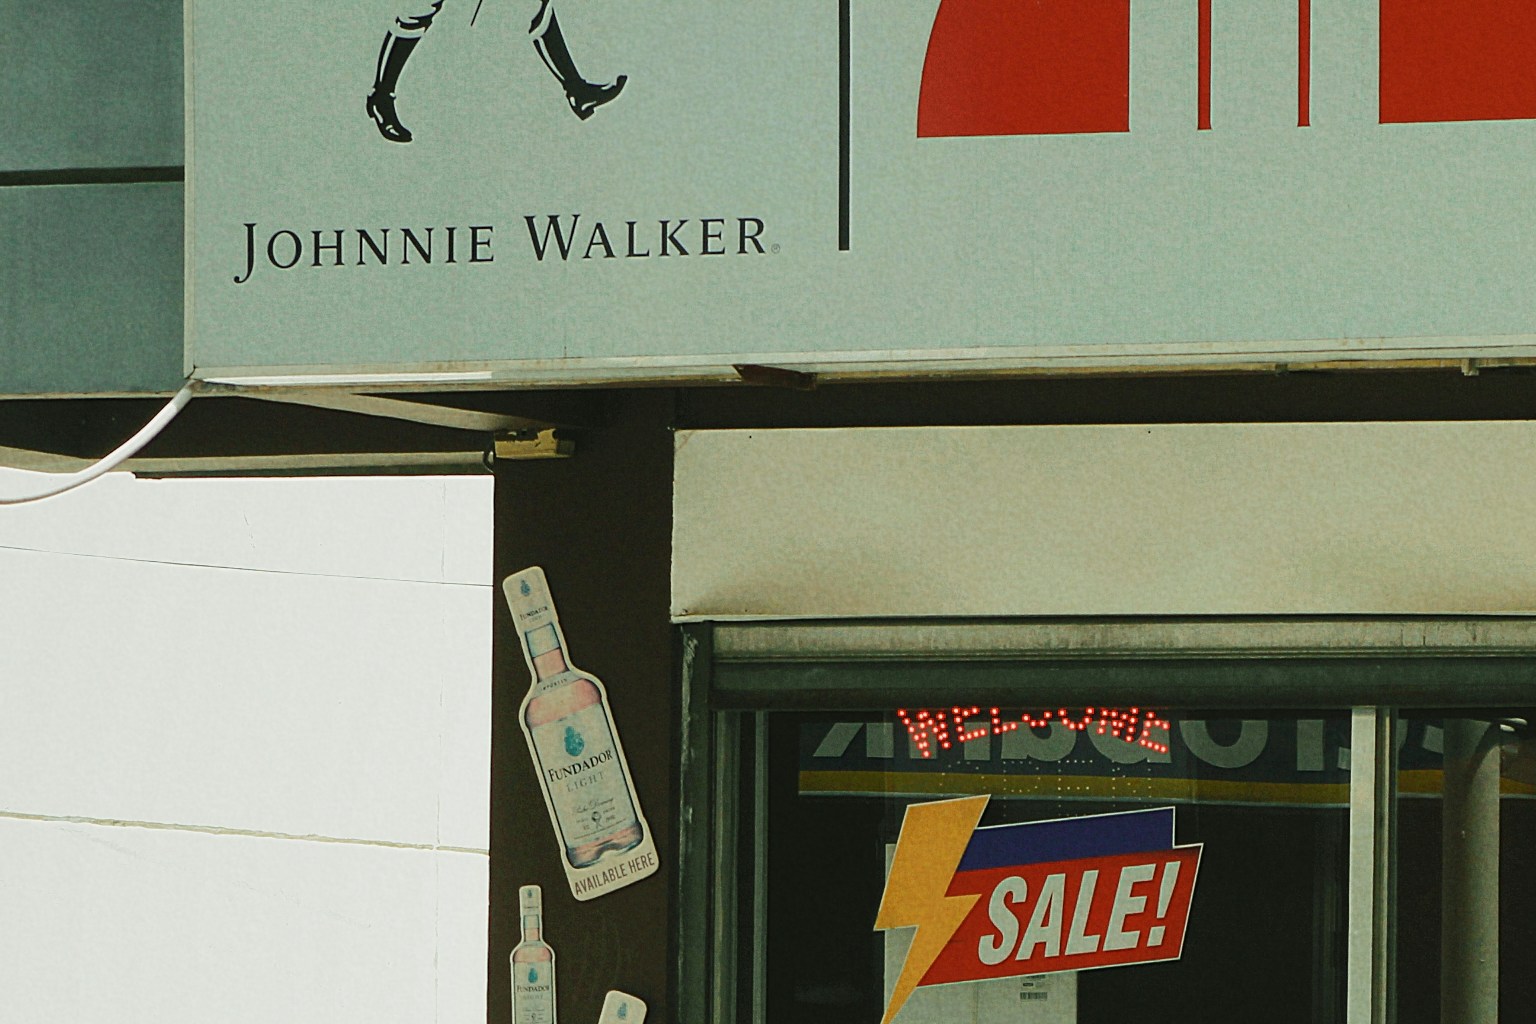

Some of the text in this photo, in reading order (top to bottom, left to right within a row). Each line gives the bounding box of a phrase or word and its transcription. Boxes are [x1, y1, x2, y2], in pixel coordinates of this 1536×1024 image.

[233, 213, 769, 284] JOHNNIE WALKER
[547, 749, 614, 783] FUNDADOR
[566, 771, 606, 793] LIGHT
[574, 853, 656, 896] AVAILABLE HERE
[977, 859, 1183, 966] SALE!
[516, 985, 550, 993] FUNDADOR
